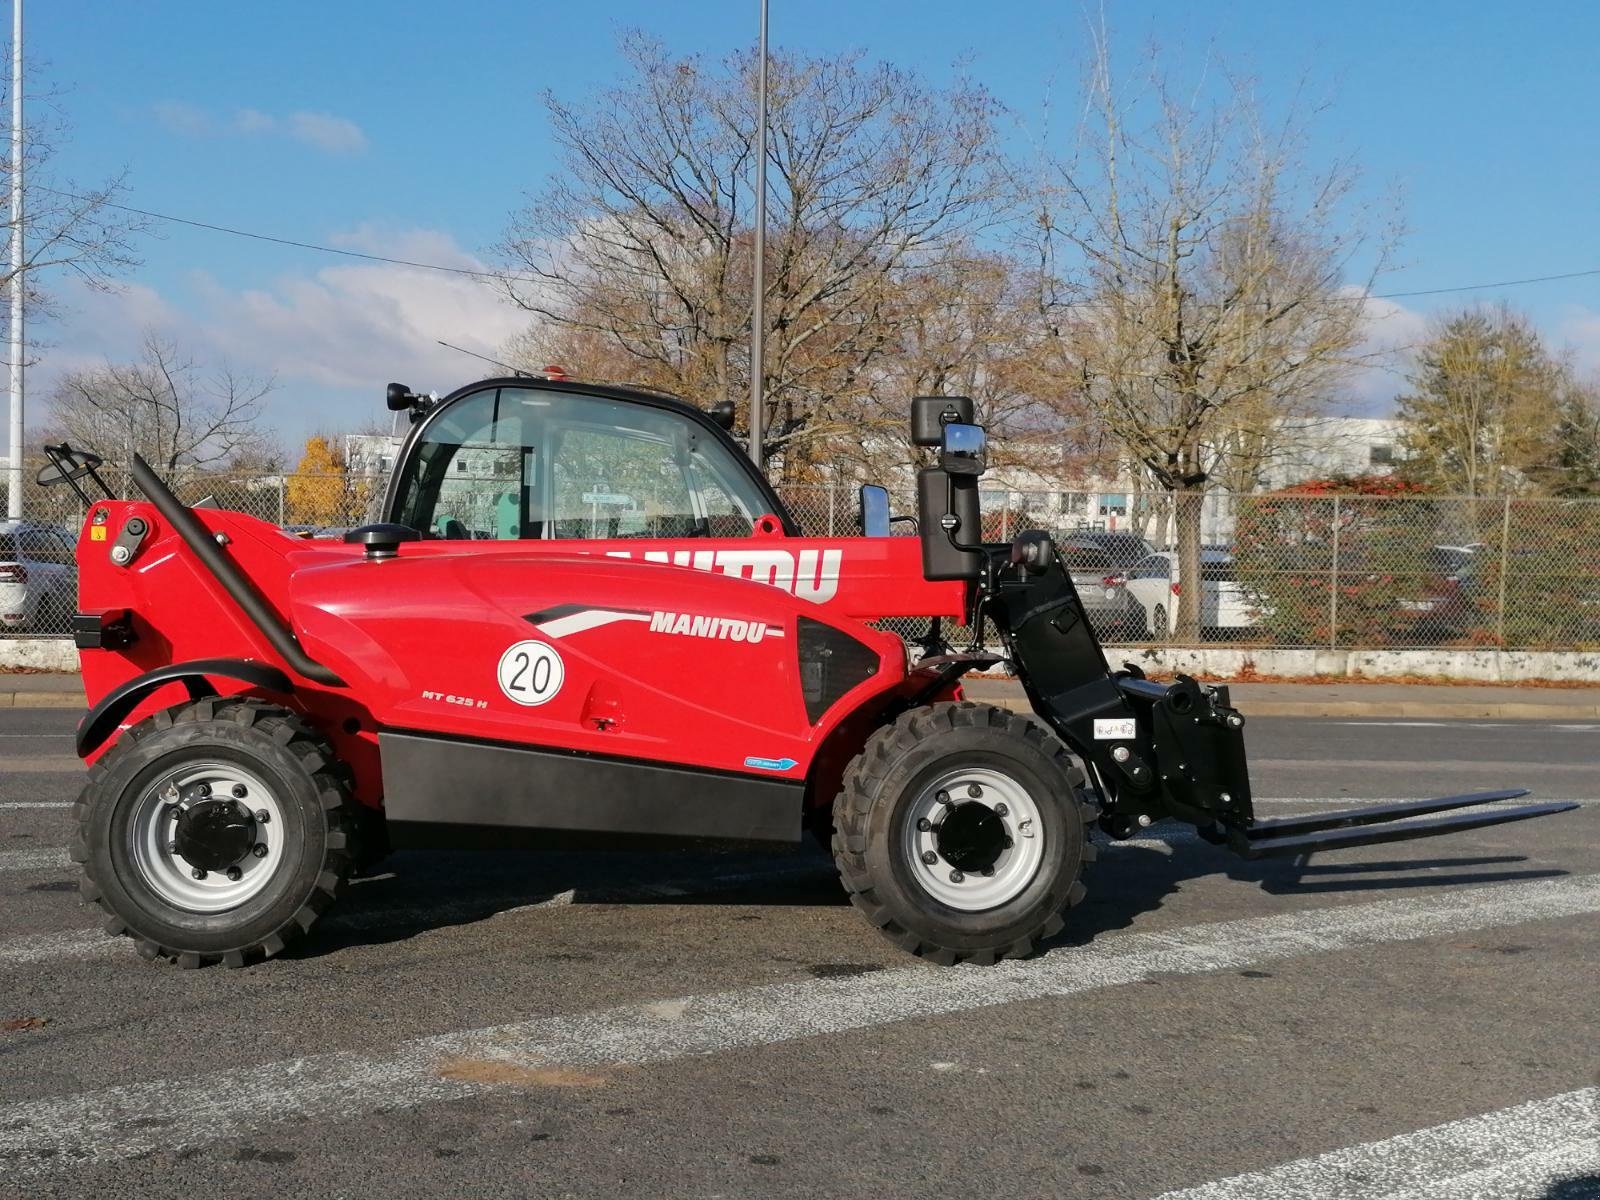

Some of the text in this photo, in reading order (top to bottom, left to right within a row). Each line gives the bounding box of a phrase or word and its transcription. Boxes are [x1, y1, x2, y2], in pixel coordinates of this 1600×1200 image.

[650, 611, 766, 644] MANITOU
[509, 652, 551, 694] 20
[421, 690, 488, 709] MT 625 H
